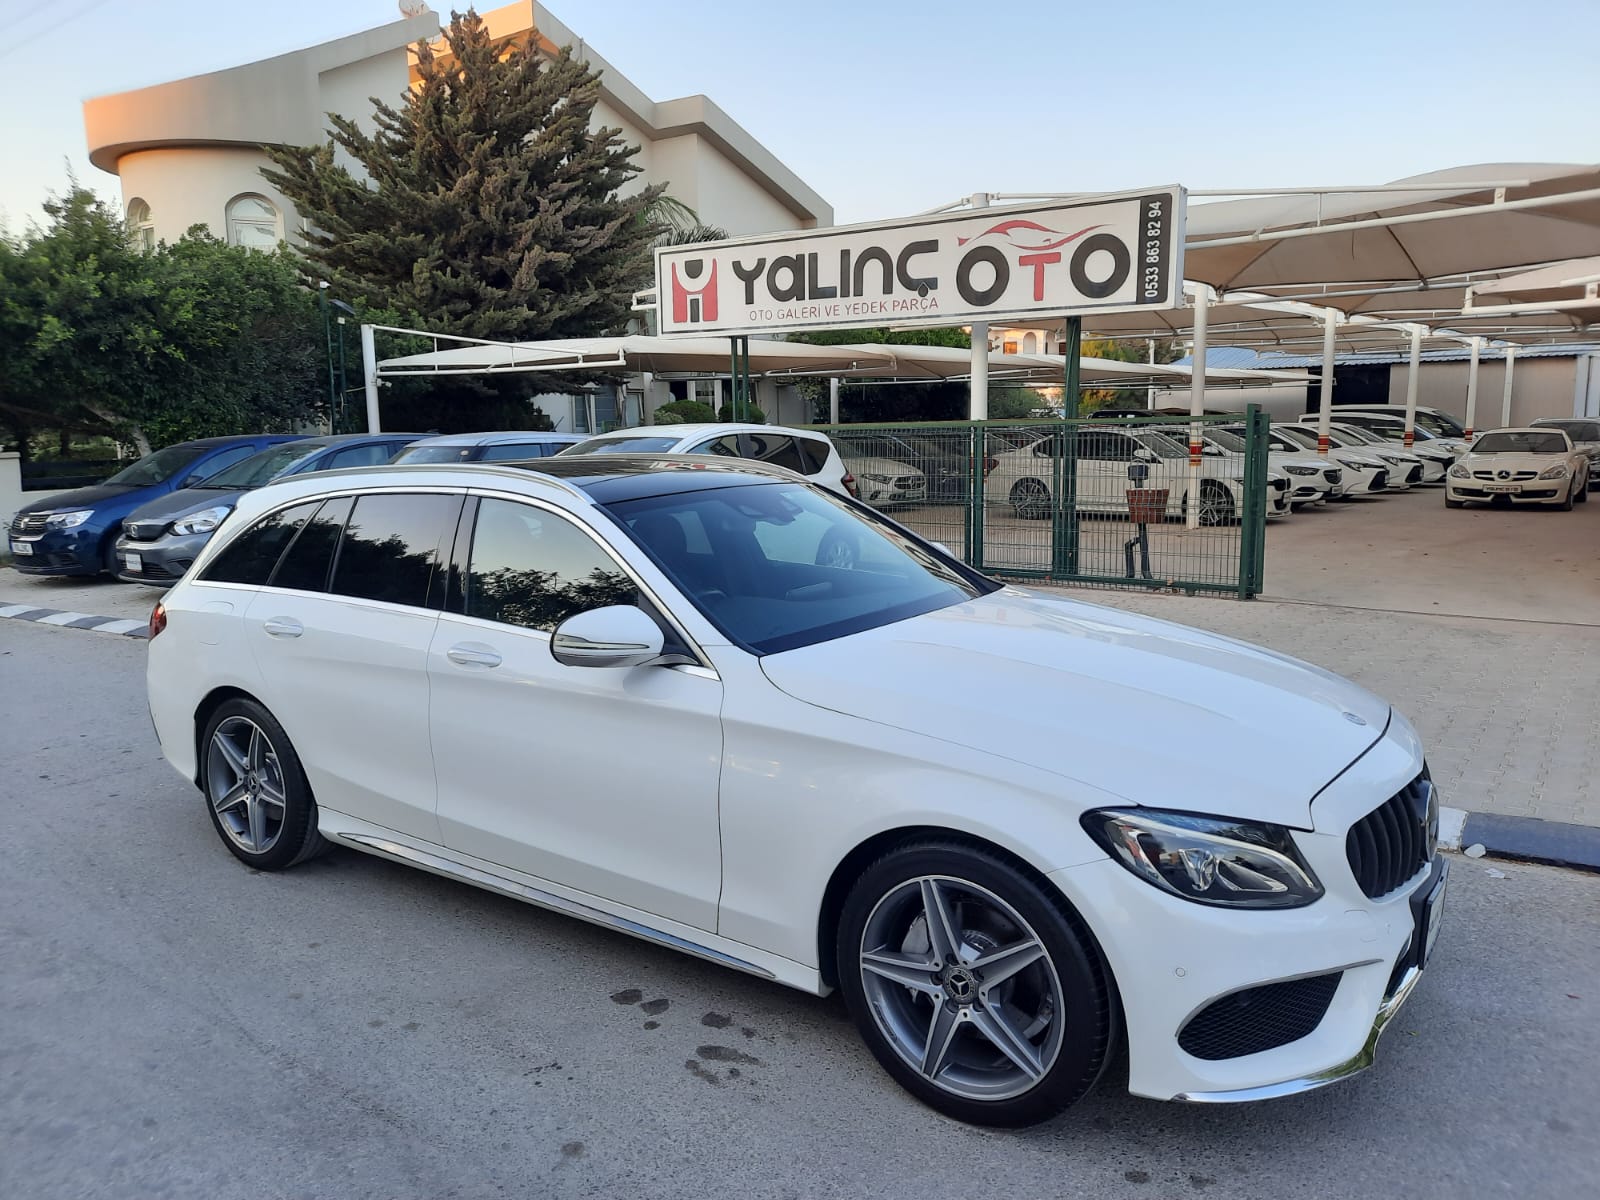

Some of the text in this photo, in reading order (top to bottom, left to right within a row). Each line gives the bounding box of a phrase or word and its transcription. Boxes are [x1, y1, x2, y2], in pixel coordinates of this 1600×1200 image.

[956, 233, 1131, 306] OTO
[1145, 201, 1162, 298] 0533 863 82 94
[750, 297, 939, 321] OTO GALERİ VE YEDEK PARÇA
